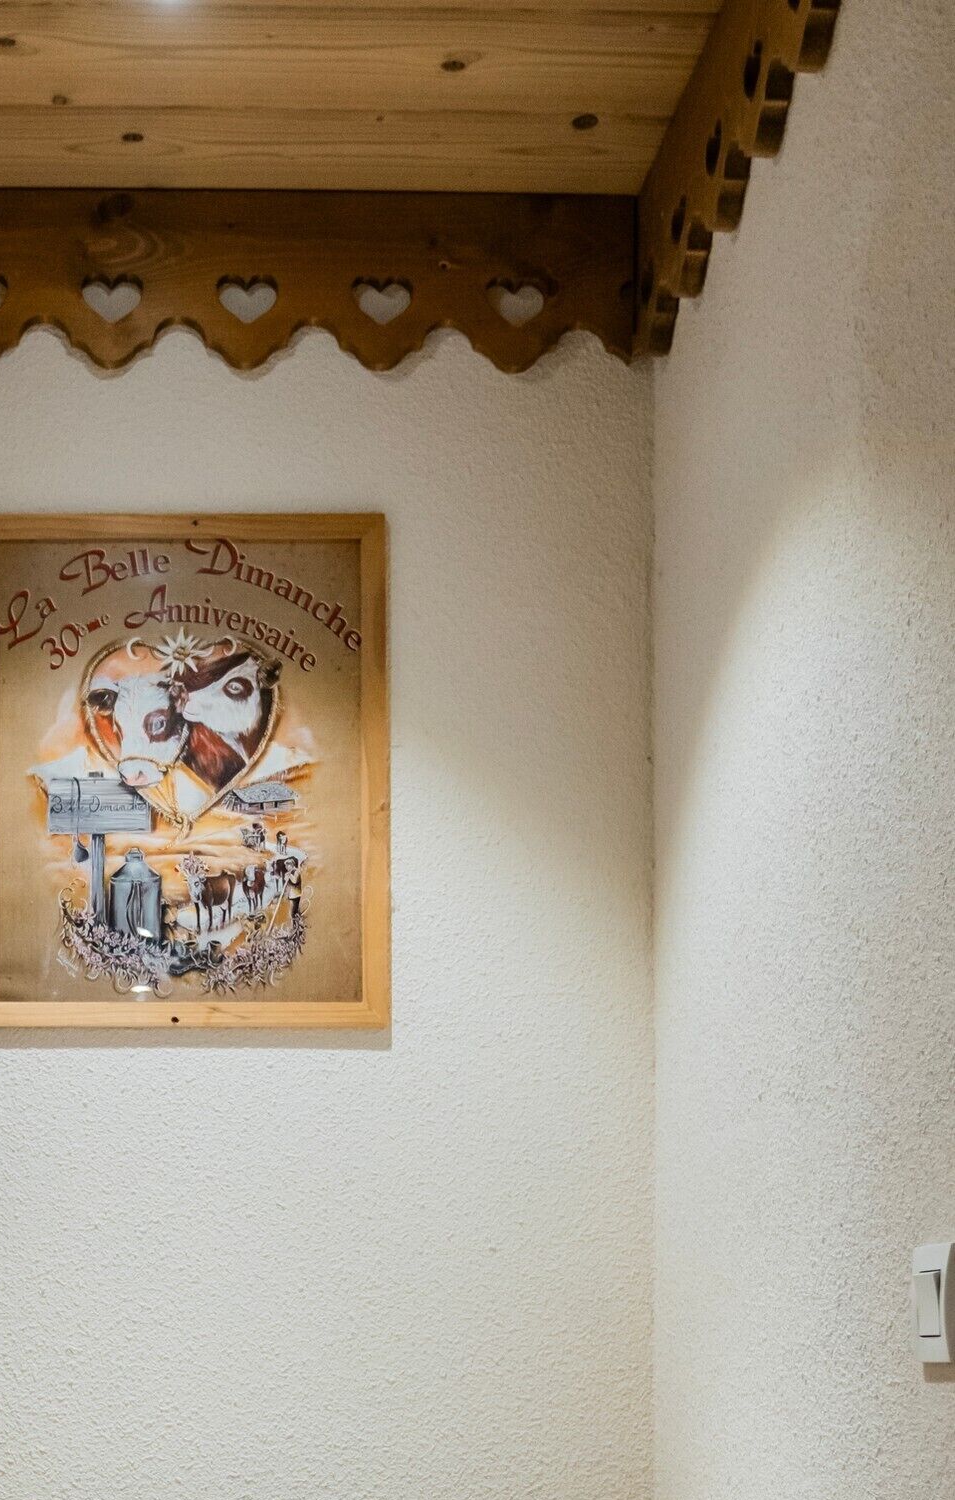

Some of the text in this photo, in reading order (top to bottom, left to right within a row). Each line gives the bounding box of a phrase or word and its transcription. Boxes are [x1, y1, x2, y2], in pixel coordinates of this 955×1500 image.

[59, 547, 171, 597] Belle
[184, 538, 363, 653] Dimanche
[124, 584, 317, 673] Anniversaire
